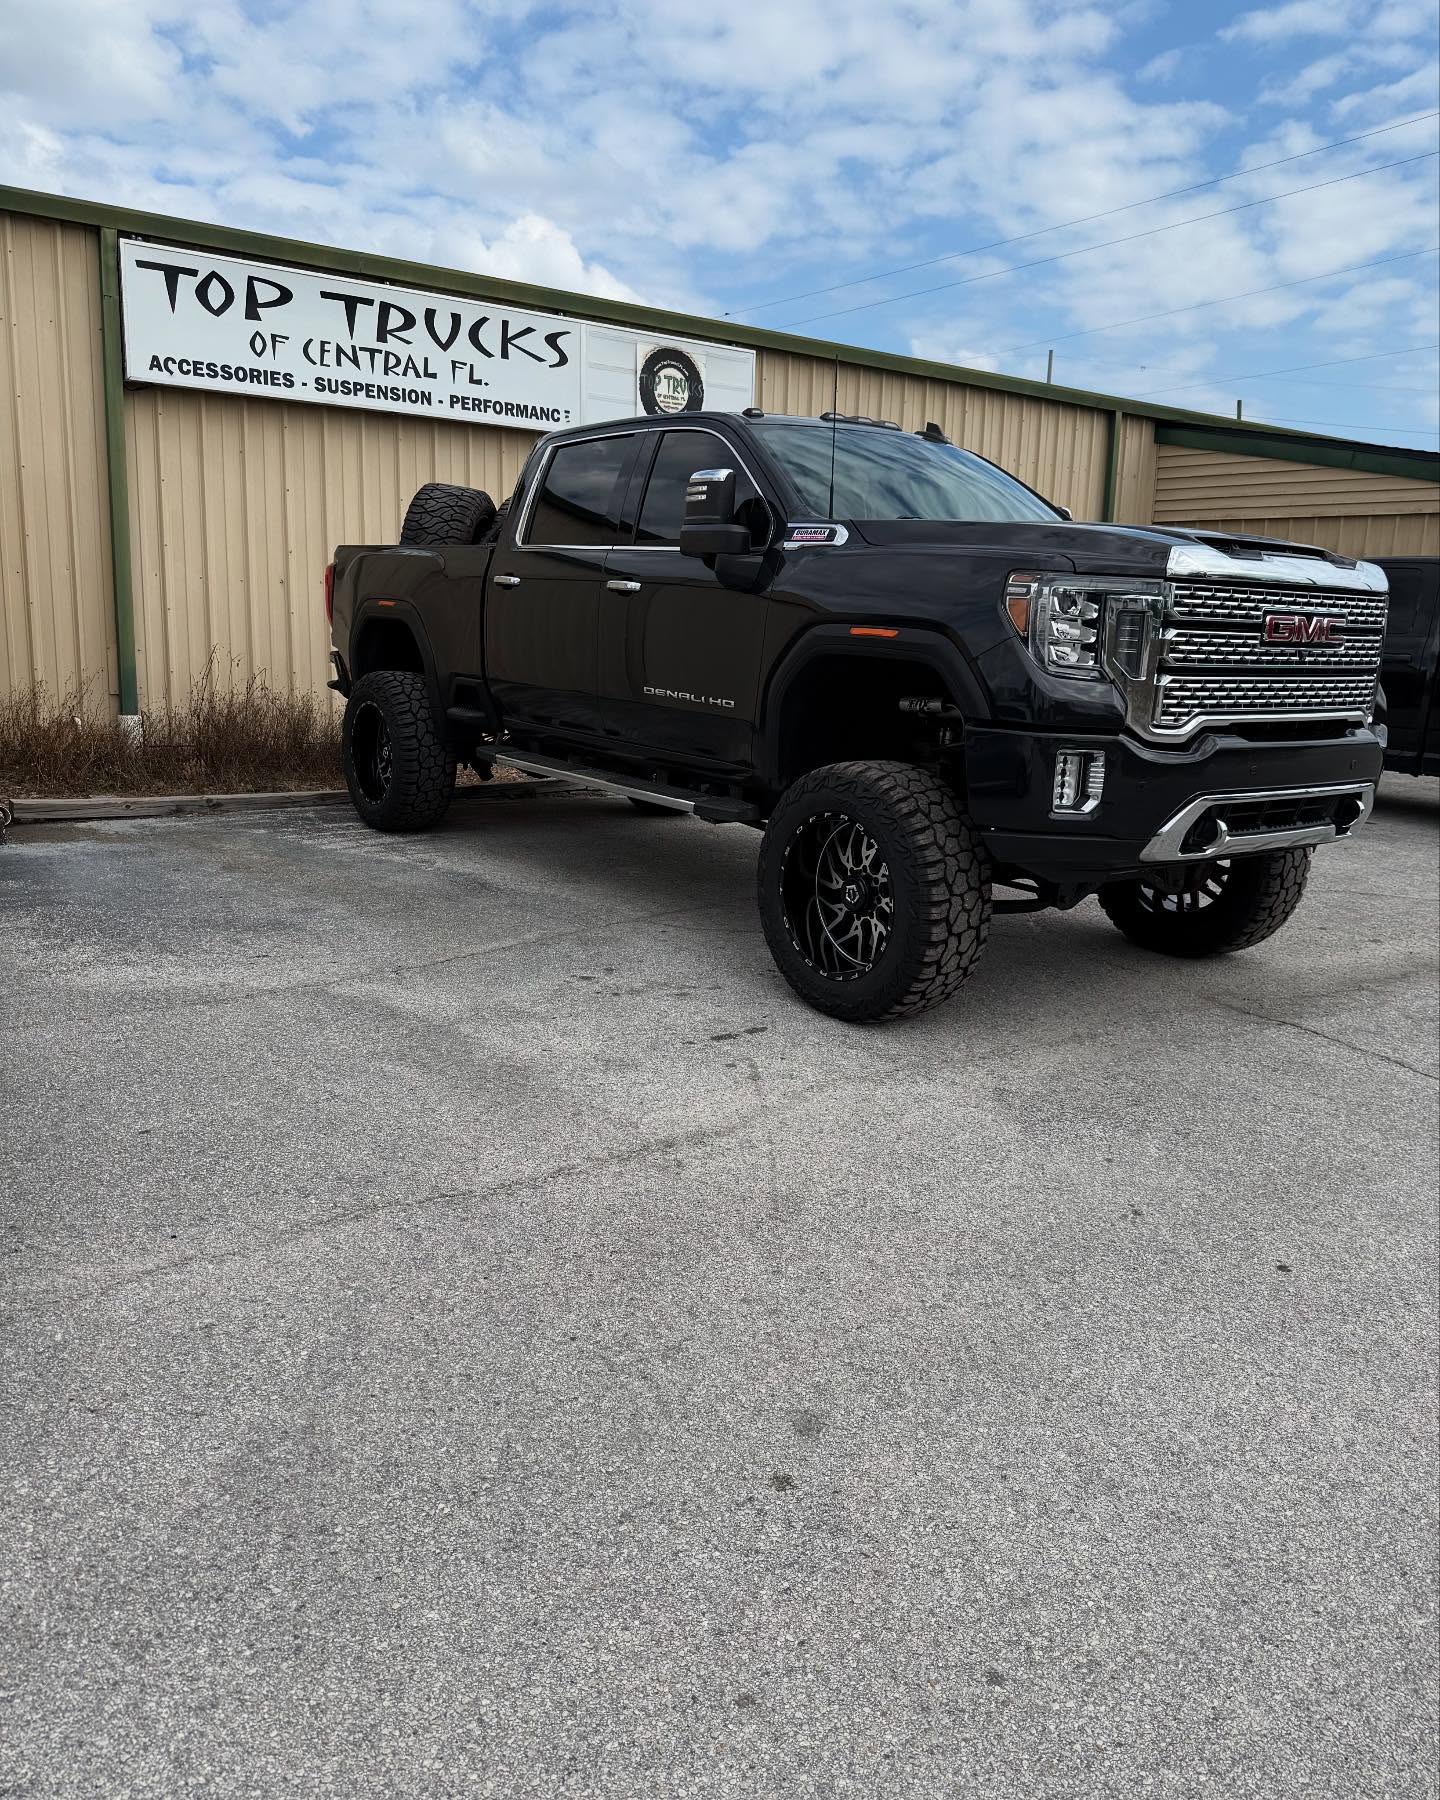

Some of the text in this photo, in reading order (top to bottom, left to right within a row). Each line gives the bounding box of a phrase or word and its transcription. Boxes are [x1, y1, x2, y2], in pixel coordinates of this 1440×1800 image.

[134, 259, 572, 369] TOP TRUCKS
[148, 354, 295, 389] ACCESSORIES
[314, 376, 432, 407] SUSPENSION
[249, 330, 490, 388] OF CENTRAL FL.
[1265, 615, 1346, 643] GMC
[643, 686, 735, 708] DENALI HD
